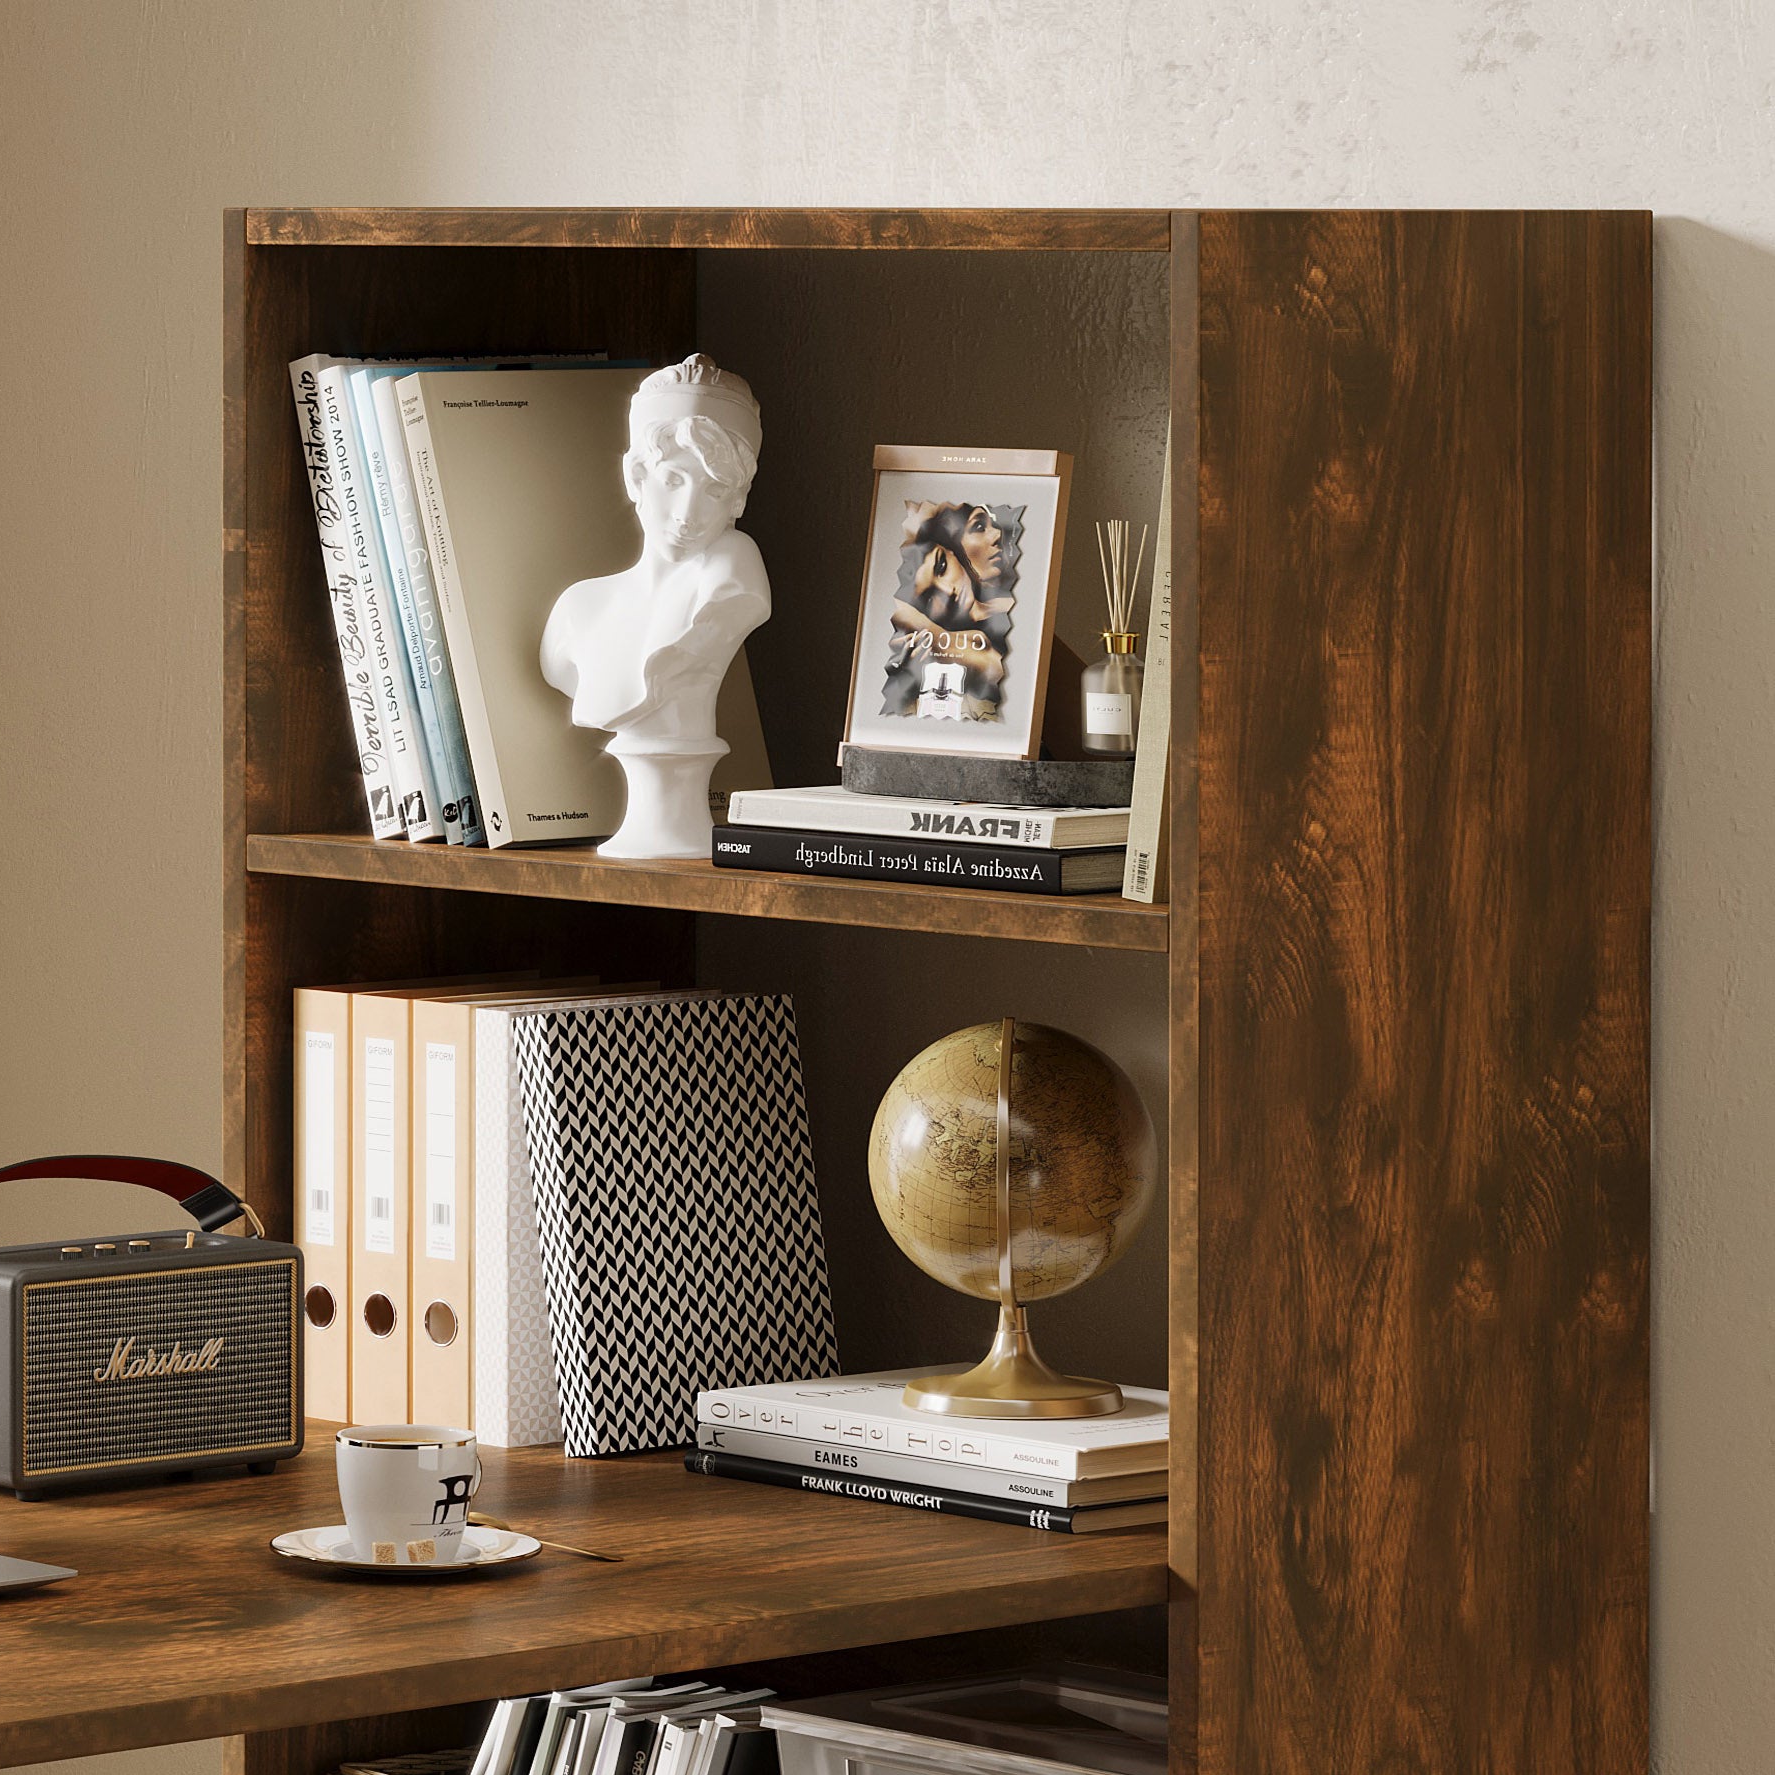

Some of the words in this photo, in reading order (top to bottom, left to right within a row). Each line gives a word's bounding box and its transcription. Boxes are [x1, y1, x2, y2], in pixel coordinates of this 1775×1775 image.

[324, 386, 339, 423] 2014
[297, 370, 342, 530] Dictatorship
[332, 430, 352, 481] SHOW
[320, 538, 346, 562] of
[330, 573, 364, 666] Beauty
[362, 573, 389, 670] GRADUATE
[414, 655, 428, 689] Arnaud
[383, 675, 401, 722] LSAD
[347, 671, 386, 775] Terrible
[393, 729, 406, 752] LIT
[527, 813, 556, 822] Thames
[561, 811, 589, 820] Hudson
[93, 1336, 224, 1382] Marshall
[711, 1402, 794, 1427] Over
[822, 1423, 884, 1441] the
[907, 1432, 981, 1457] Top
[814, 1450, 858, 1468] EAMES
[1013, 1452, 1060, 1467] ASSOULINE
[801, 1475, 844, 1493] FRANK
[845, 1483, 888, 1501] LLOYD
[888, 1490, 943, 1511] WRIGHT
[1008, 1484, 1054, 1498] ASSOULINE
